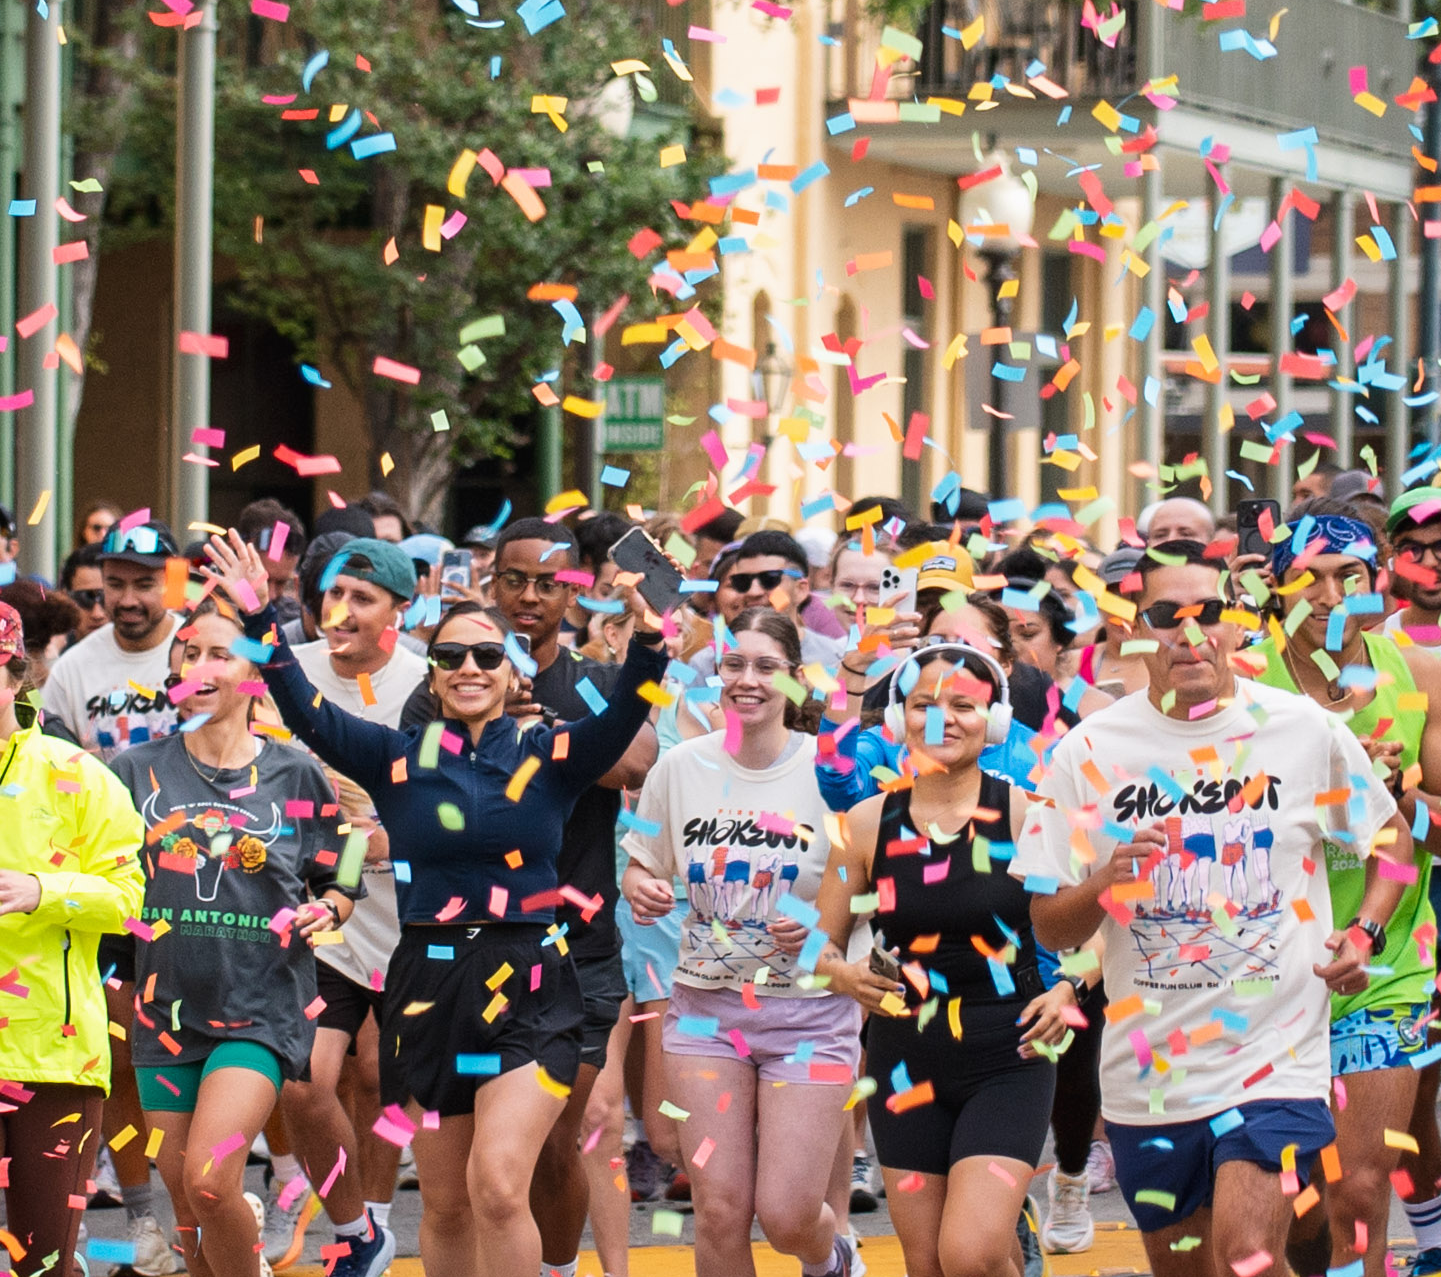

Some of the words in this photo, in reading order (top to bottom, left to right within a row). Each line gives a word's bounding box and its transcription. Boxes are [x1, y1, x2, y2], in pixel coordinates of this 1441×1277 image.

[607, 384, 661, 418] ATM
[142, 907, 173, 921] SAN
[180, 909, 271, 929] ANTONIO
[180, 924, 271, 943] MARATHON
